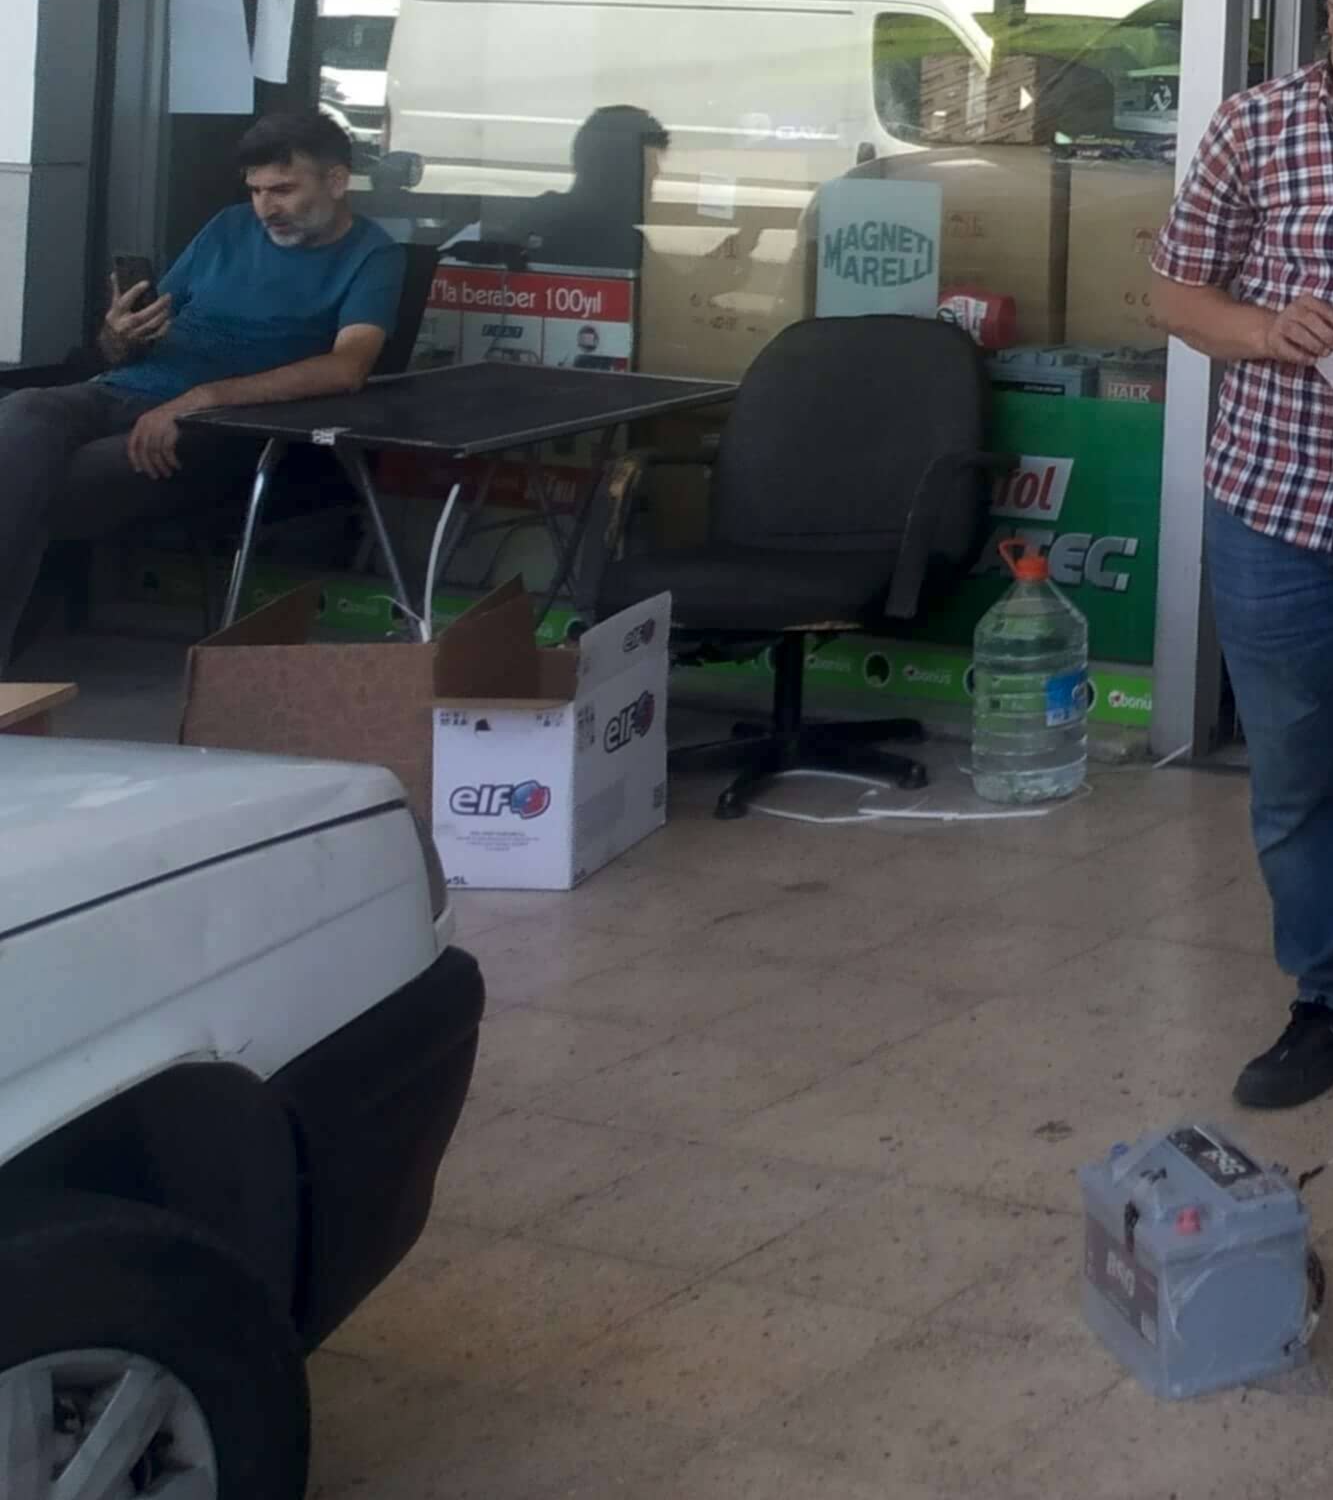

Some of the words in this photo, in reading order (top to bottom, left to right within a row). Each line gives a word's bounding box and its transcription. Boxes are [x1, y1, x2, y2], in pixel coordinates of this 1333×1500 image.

[823, 220, 934, 256] MAGNETI
[823, 250, 934, 288] MARELLI
[461, 281, 537, 310] beraber
[545, 286, 603, 319] 100yıl
[1120, 692, 1153, 710] bonu
[450, 784, 513, 817] elf
